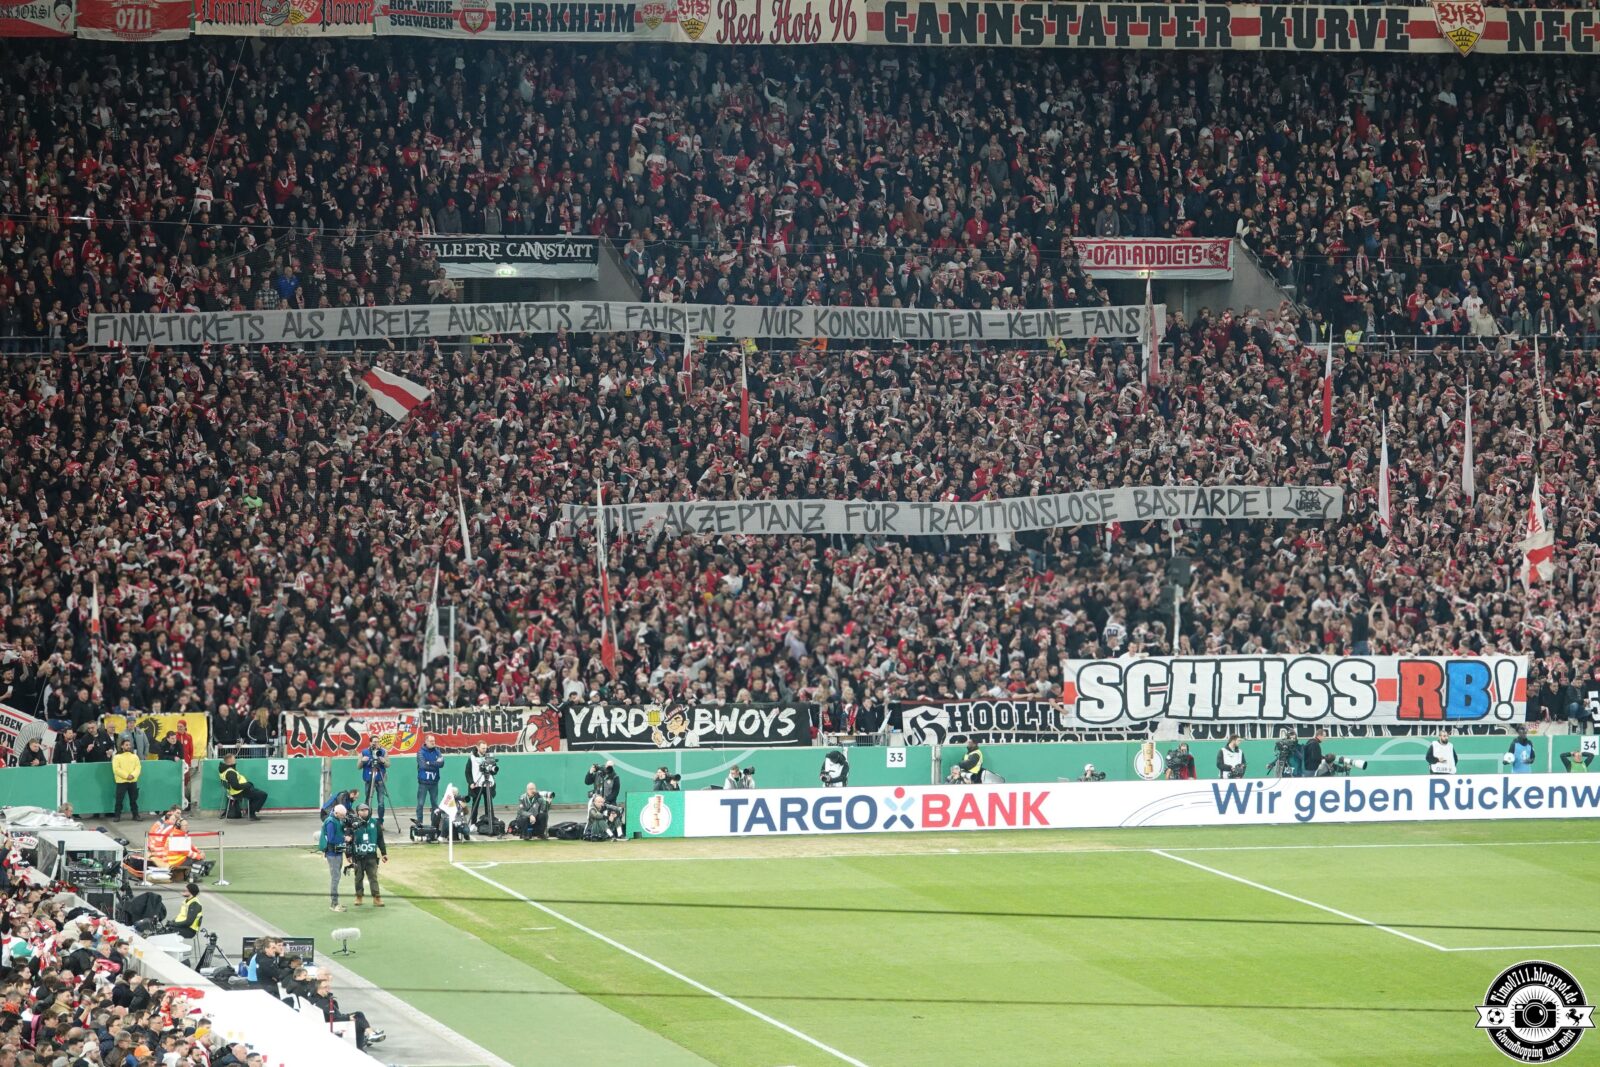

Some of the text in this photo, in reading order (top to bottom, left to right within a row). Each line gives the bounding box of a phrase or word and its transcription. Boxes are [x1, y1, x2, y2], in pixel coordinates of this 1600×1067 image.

[116, 8, 151, 30] 0711
[282, 27, 309, 36] 2005
[319, 0, 371, 32] Power
[390, 14, 453, 29] SCHWABEN
[495, 2, 636, 33] BERKHEIM
[716, 0, 857, 44] Red Hots 96
[884, 1, 1409, 51] CANNSTATTER KURVE
[1507, 10, 1594, 52] NEC
[506, 241, 593, 260] CANNSTATT
[1093, 245, 1127, 265] 0711
[1132, 244, 1202, 265] ADDICTS
[94, 312, 264, 343] FINALTICKETS
[282, 310, 325, 339] ALS
[338, 308, 430, 337] ANREIZ
[448, 302, 571, 333] AUSWÄRTS
[580, 302, 612, 331] ZU
[758, 306, 803, 336] NUR
[1081, 307, 1141, 335] FANS
[664, 502, 825, 533] AKZEPTANZ
[844, 503, 900, 533] FÜR
[911, 493, 1118, 533] TRADITIONSLOSE
[1076, 657, 1377, 724] SCHEISS
[422, 709, 524, 735] SUPPORTERS
[569, 705, 648, 738] YARD
[694, 707, 798, 738] BWOYS
[944, 702, 1063, 733] HOOLI
[889, 752, 904, 763] 33
[1583, 741, 1597, 751] 34
[270, 764, 286, 775] 32
[425, 771, 437, 780] TV
[720, 791, 1051, 833] TARGO BANK
[1211, 781, 1282, 815] Wir
[1294, 779, 1413, 822] geben
